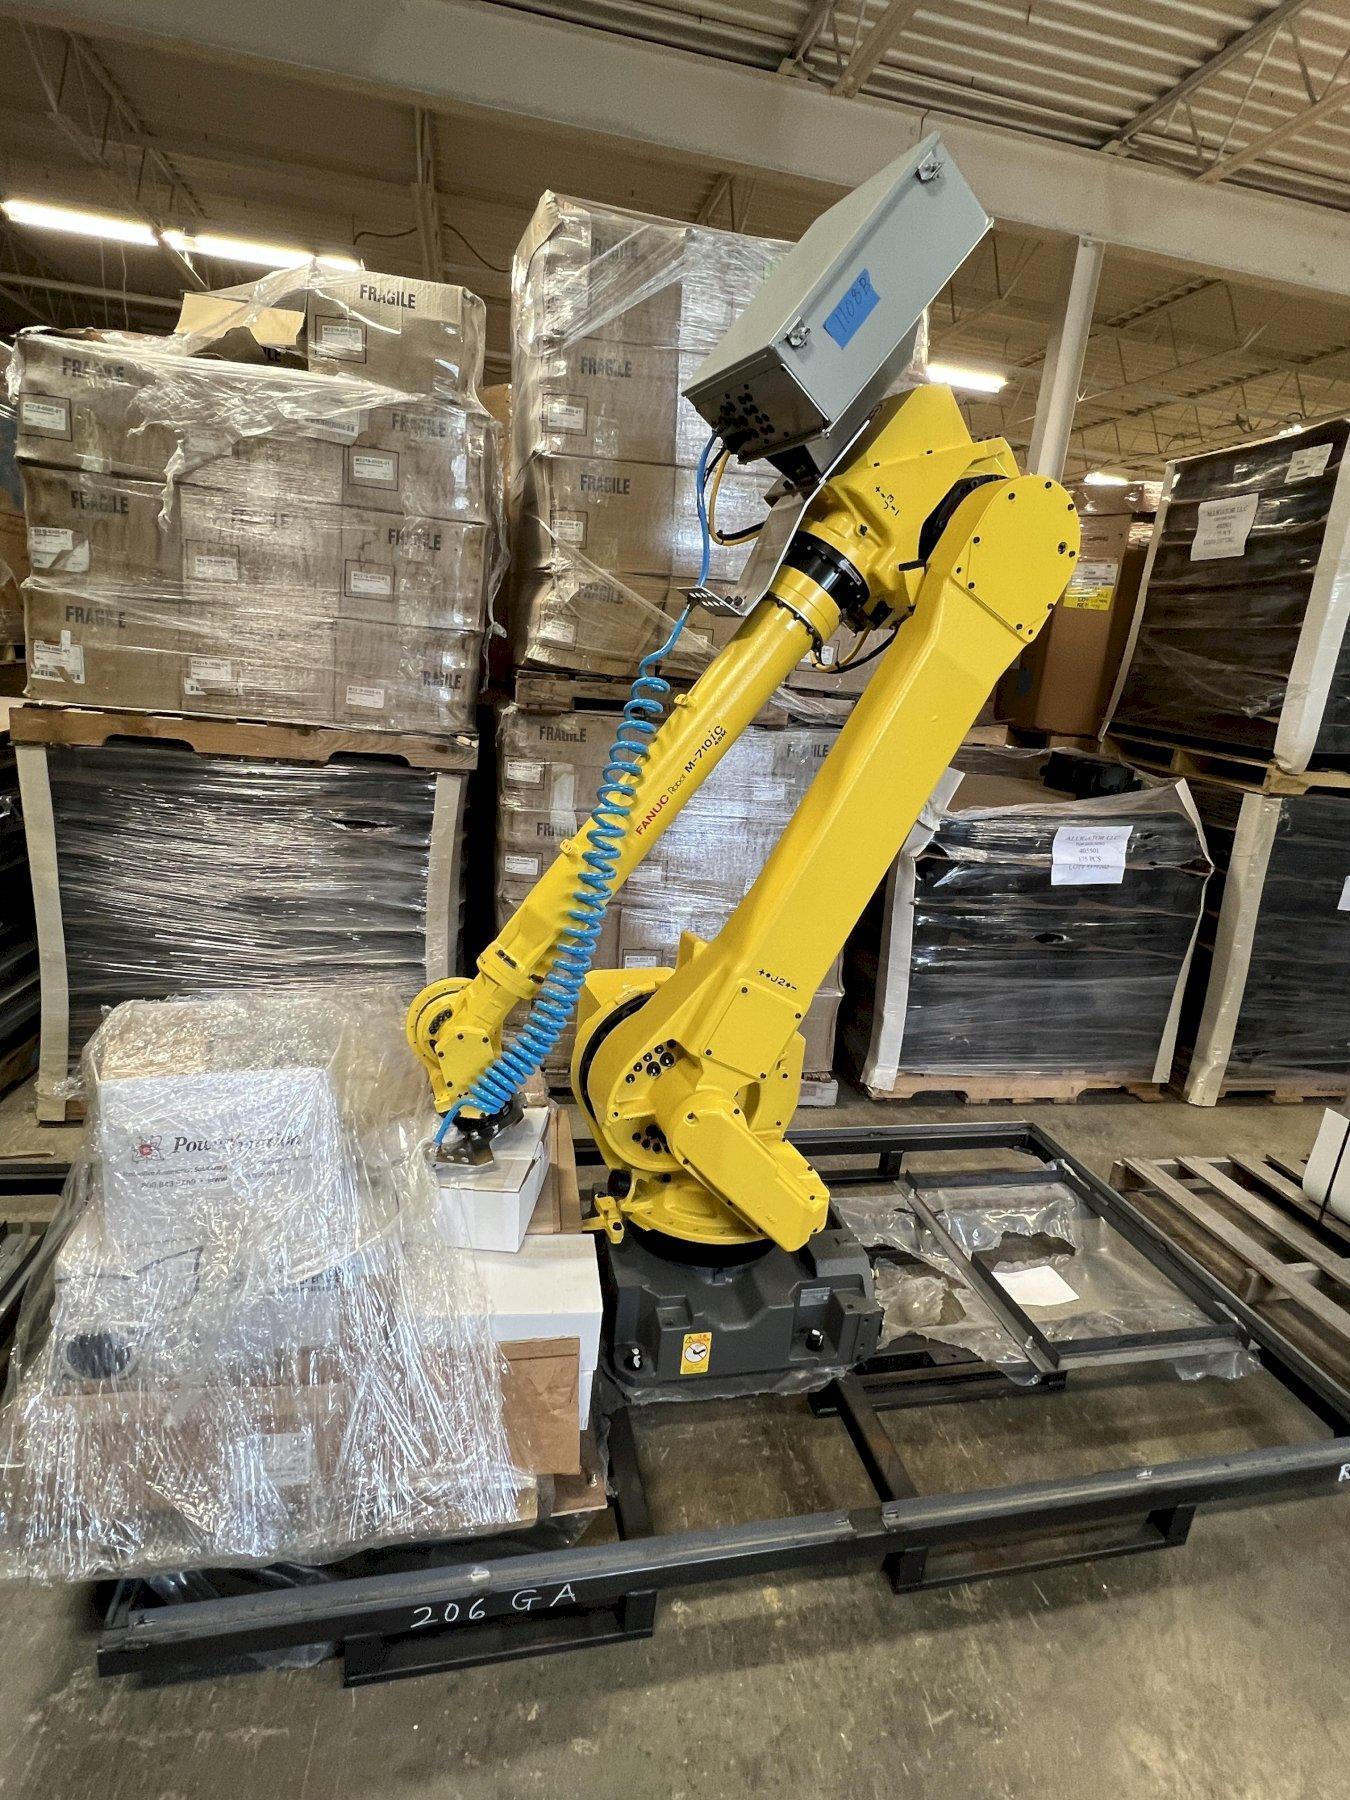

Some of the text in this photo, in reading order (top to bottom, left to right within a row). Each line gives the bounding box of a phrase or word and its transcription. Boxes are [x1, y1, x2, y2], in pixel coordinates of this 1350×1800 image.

[359, 284, 416, 309] FRAGILE
[580, 474, 631, 495] FRAGILE
[635, 794, 670, 836] FANUC
[667, 773, 687, 794] Robot
[684, 725, 723, 774] M-710iC
[410, 1598, 486, 1628] 206
